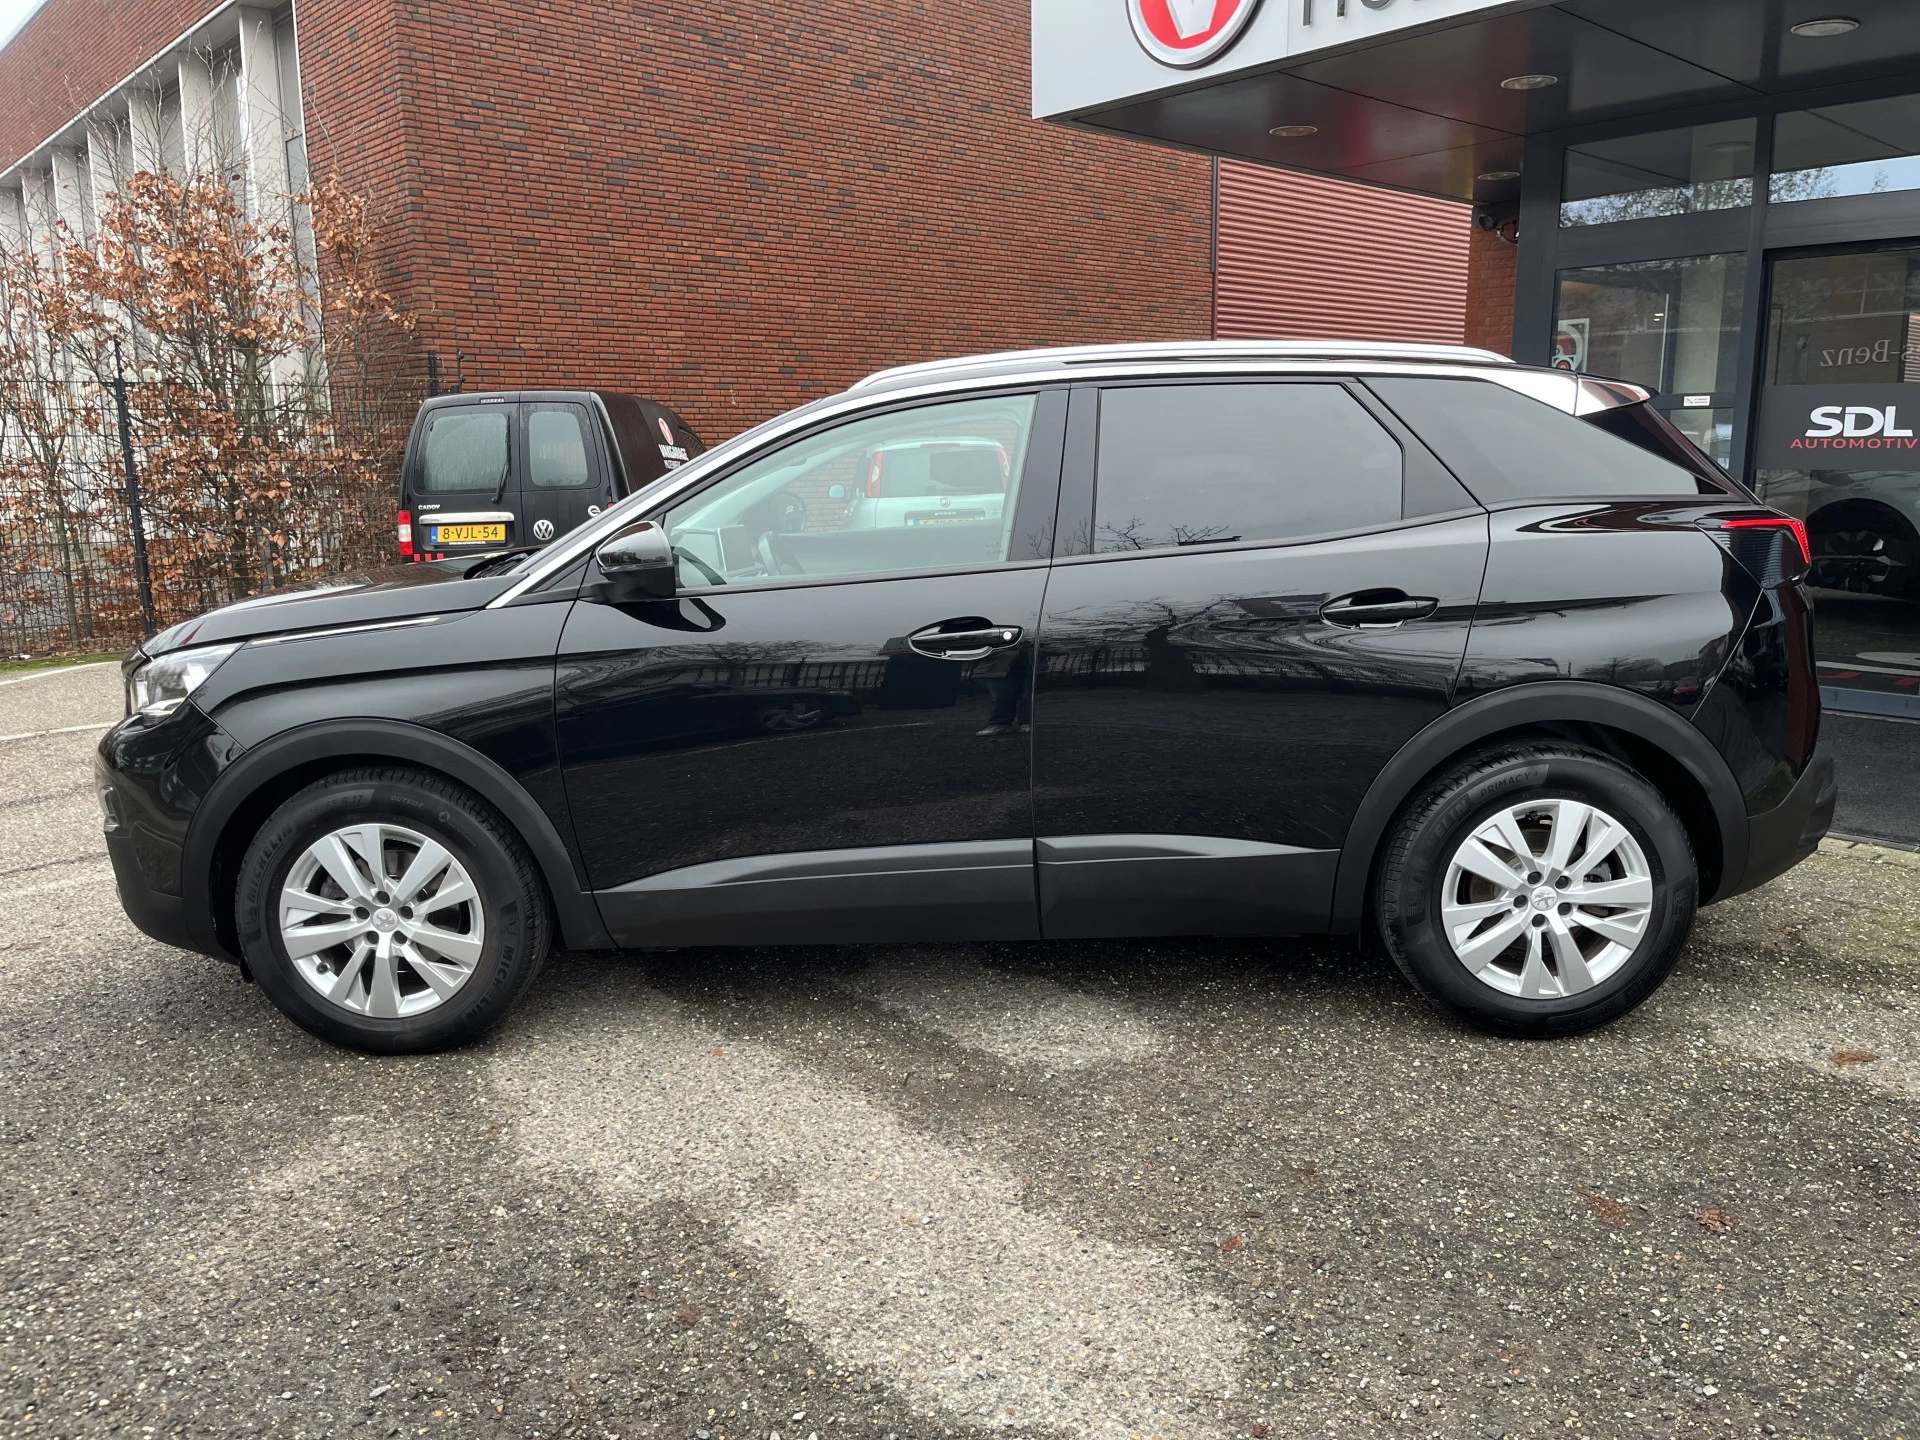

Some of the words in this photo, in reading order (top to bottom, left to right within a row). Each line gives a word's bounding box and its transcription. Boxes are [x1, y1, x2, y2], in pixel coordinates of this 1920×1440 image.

[1805, 405, 1914, 437] SDL
[1789, 438, 1919, 449] AUTOMOTIV
[443, 525, 499, 540] 8-VJL-54
[1480, 771, 1532, 799] PRIMACY
[390, 795, 425, 809] OUTSIDE
[246, 823, 295, 904] MICHELIN
